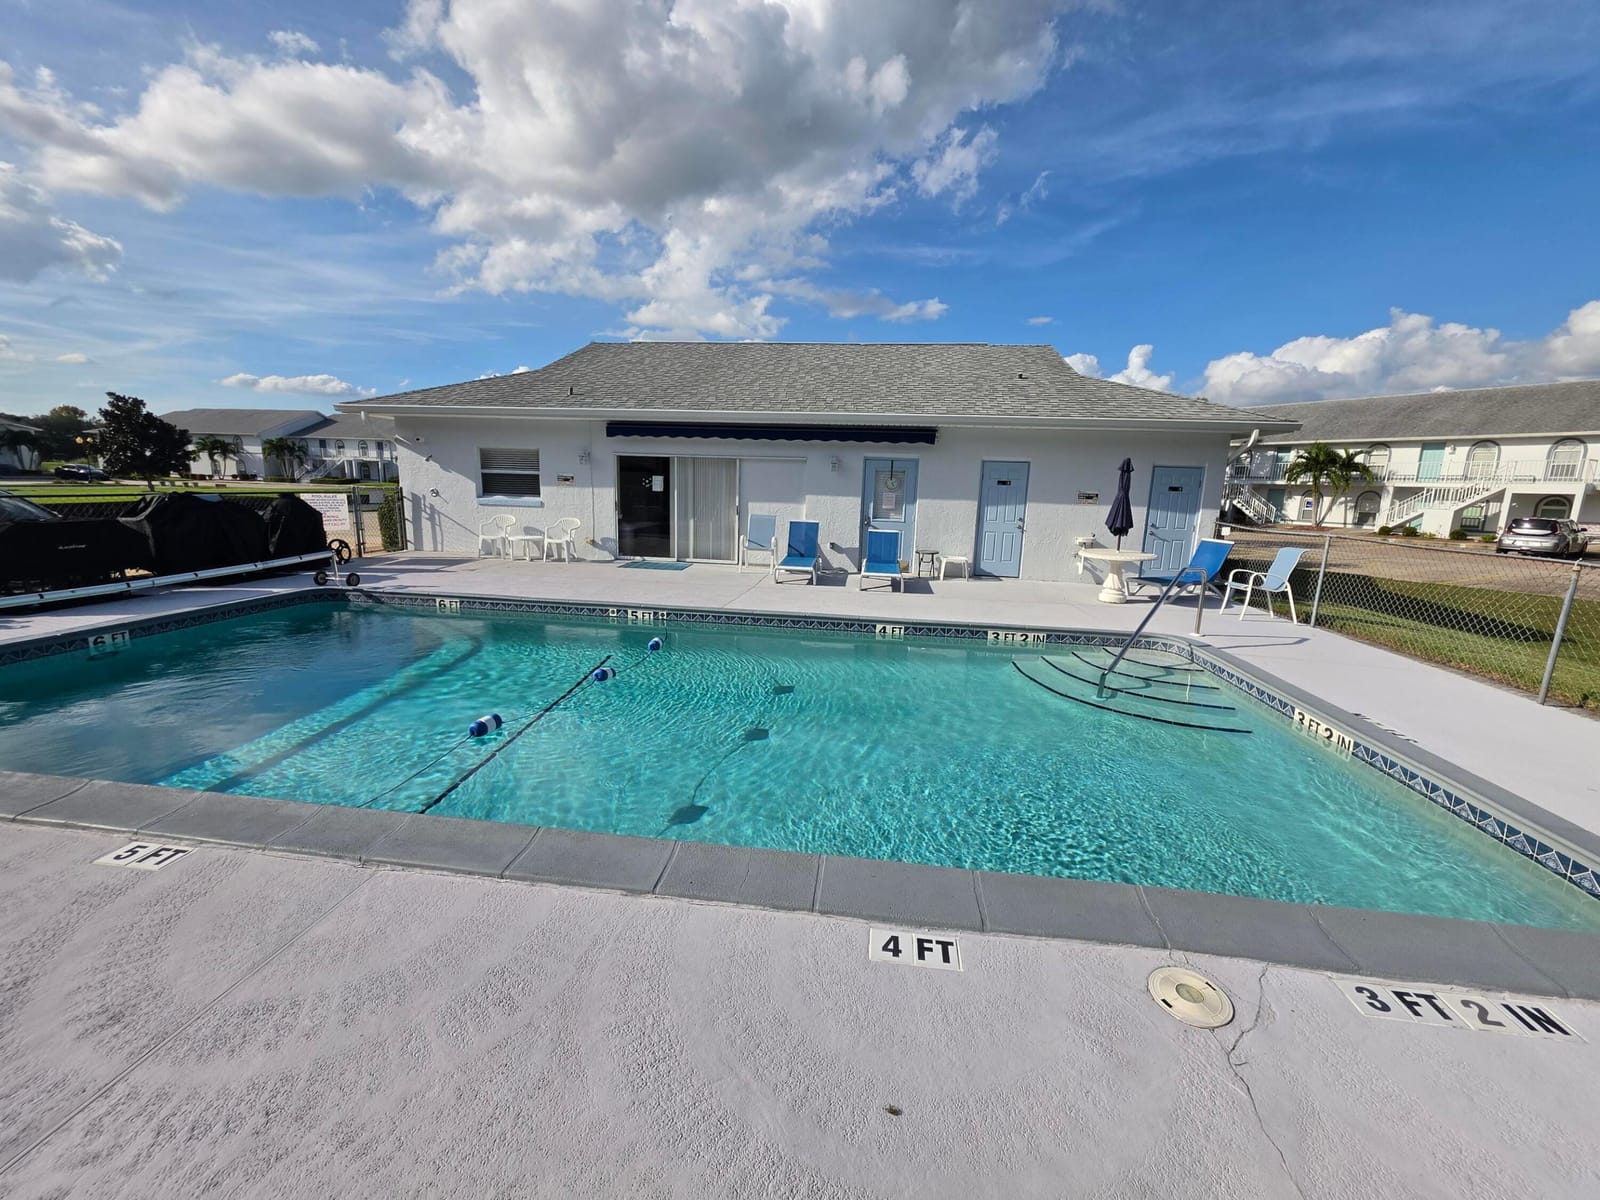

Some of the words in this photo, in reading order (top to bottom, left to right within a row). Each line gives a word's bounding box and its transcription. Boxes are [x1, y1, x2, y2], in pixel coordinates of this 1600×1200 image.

[438, 600, 446, 608] 6
[631, 610, 639, 620] 5
[642, 611, 652, 620] FT
[891, 626, 903, 635] FT
[992, 632, 1000, 641] 3
[1004, 632, 1016, 641] FT
[1033, 634, 1045, 643] IN
[93, 635, 107, 646] 6
[111, 631, 128, 643] FT
[1308, 718, 1321, 735] FT
[1337, 734, 1351, 752] IN
[113, 844, 150, 861] 5
[136, 847, 189, 866] FT
[881, 935, 903, 958] 4
[916, 937, 955, 964] FT
[1354, 986, 1392, 1013] 3
[1391, 990, 1453, 1021] FT
[1460, 999, 1506, 1028] 2
[1501, 1003, 1573, 1036] IN
